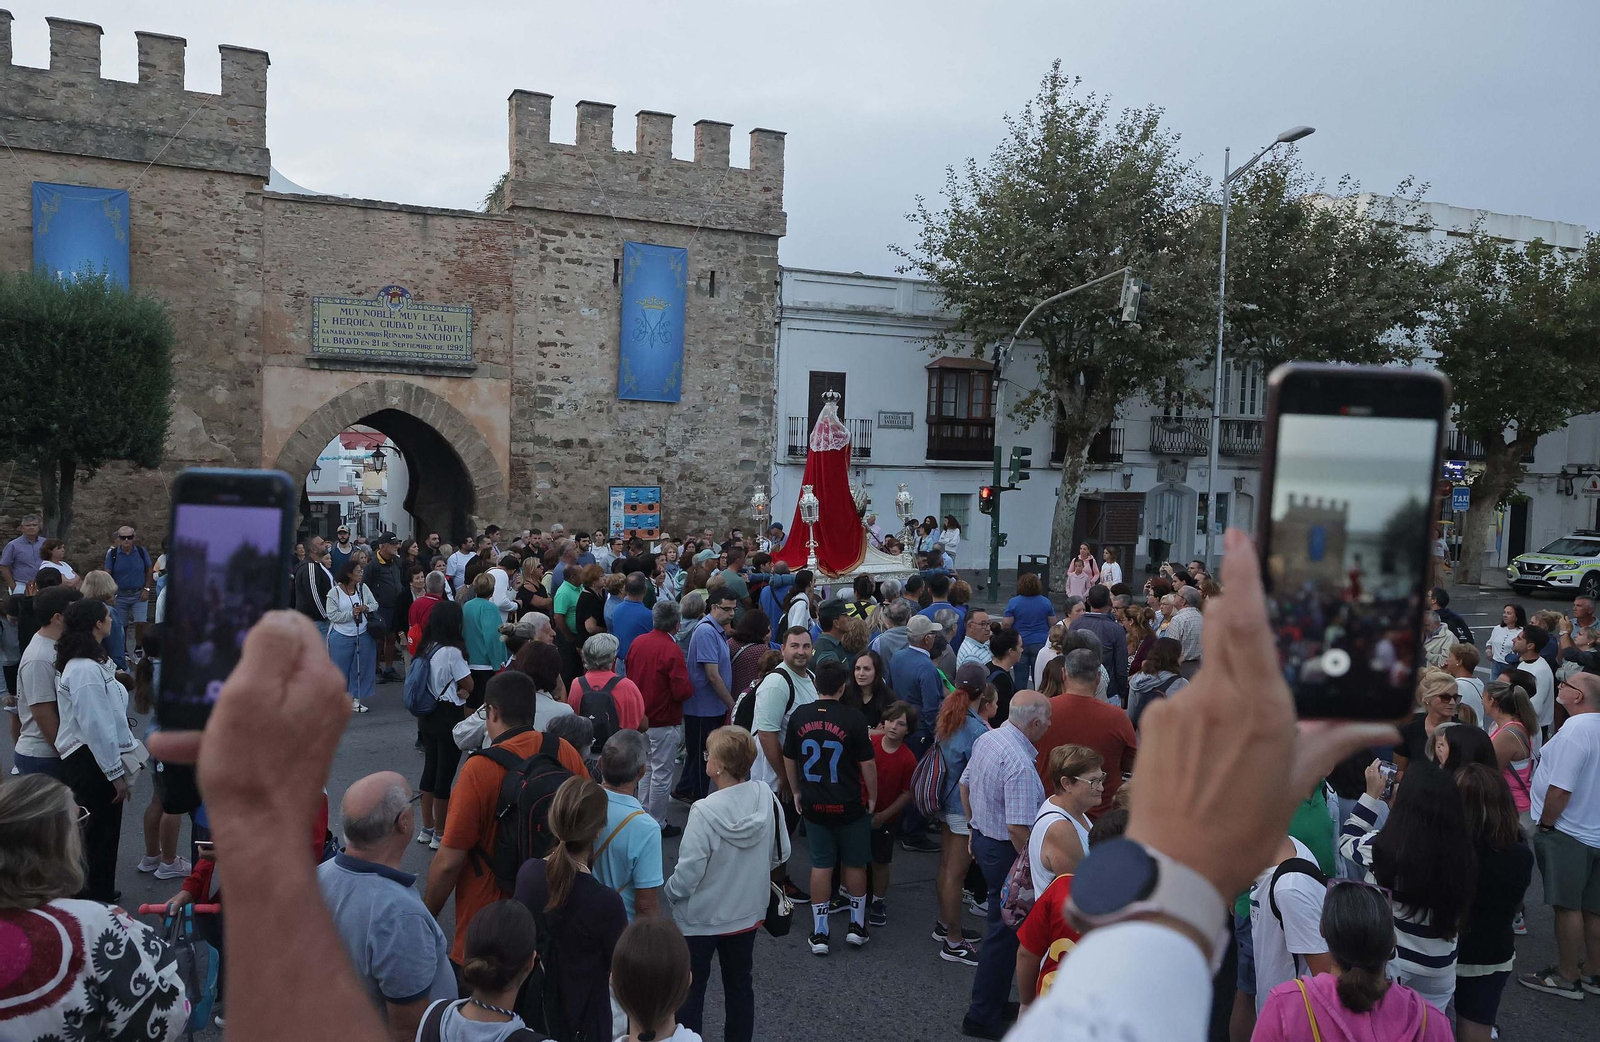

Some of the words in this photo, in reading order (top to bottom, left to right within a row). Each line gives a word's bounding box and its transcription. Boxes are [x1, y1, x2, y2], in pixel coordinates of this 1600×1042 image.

[340, 308, 360, 317] MUY
[400, 312, 419, 321] MUY
[423, 313, 446, 323] LEAL
[332, 316, 375, 328] HEROICA
[380, 320, 414, 330] CIUDAD
[432, 323, 463, 333] TARIFA
[321, 328, 346, 336] GANADA
[415, 331, 451, 342] SANCHO
[454, 334, 464, 342] IV
[333, 336, 359, 345] BRAVO
[371, 339, 380, 347] 21
[447, 343, 464, 352] 1292
[1453, 495, 1470, 503] TAXI
[797, 720, 823, 737] LAMINE
[824, 721, 847, 740] YAMAL
[801, 738, 844, 784] 27
[816, 907, 829, 916] 10
